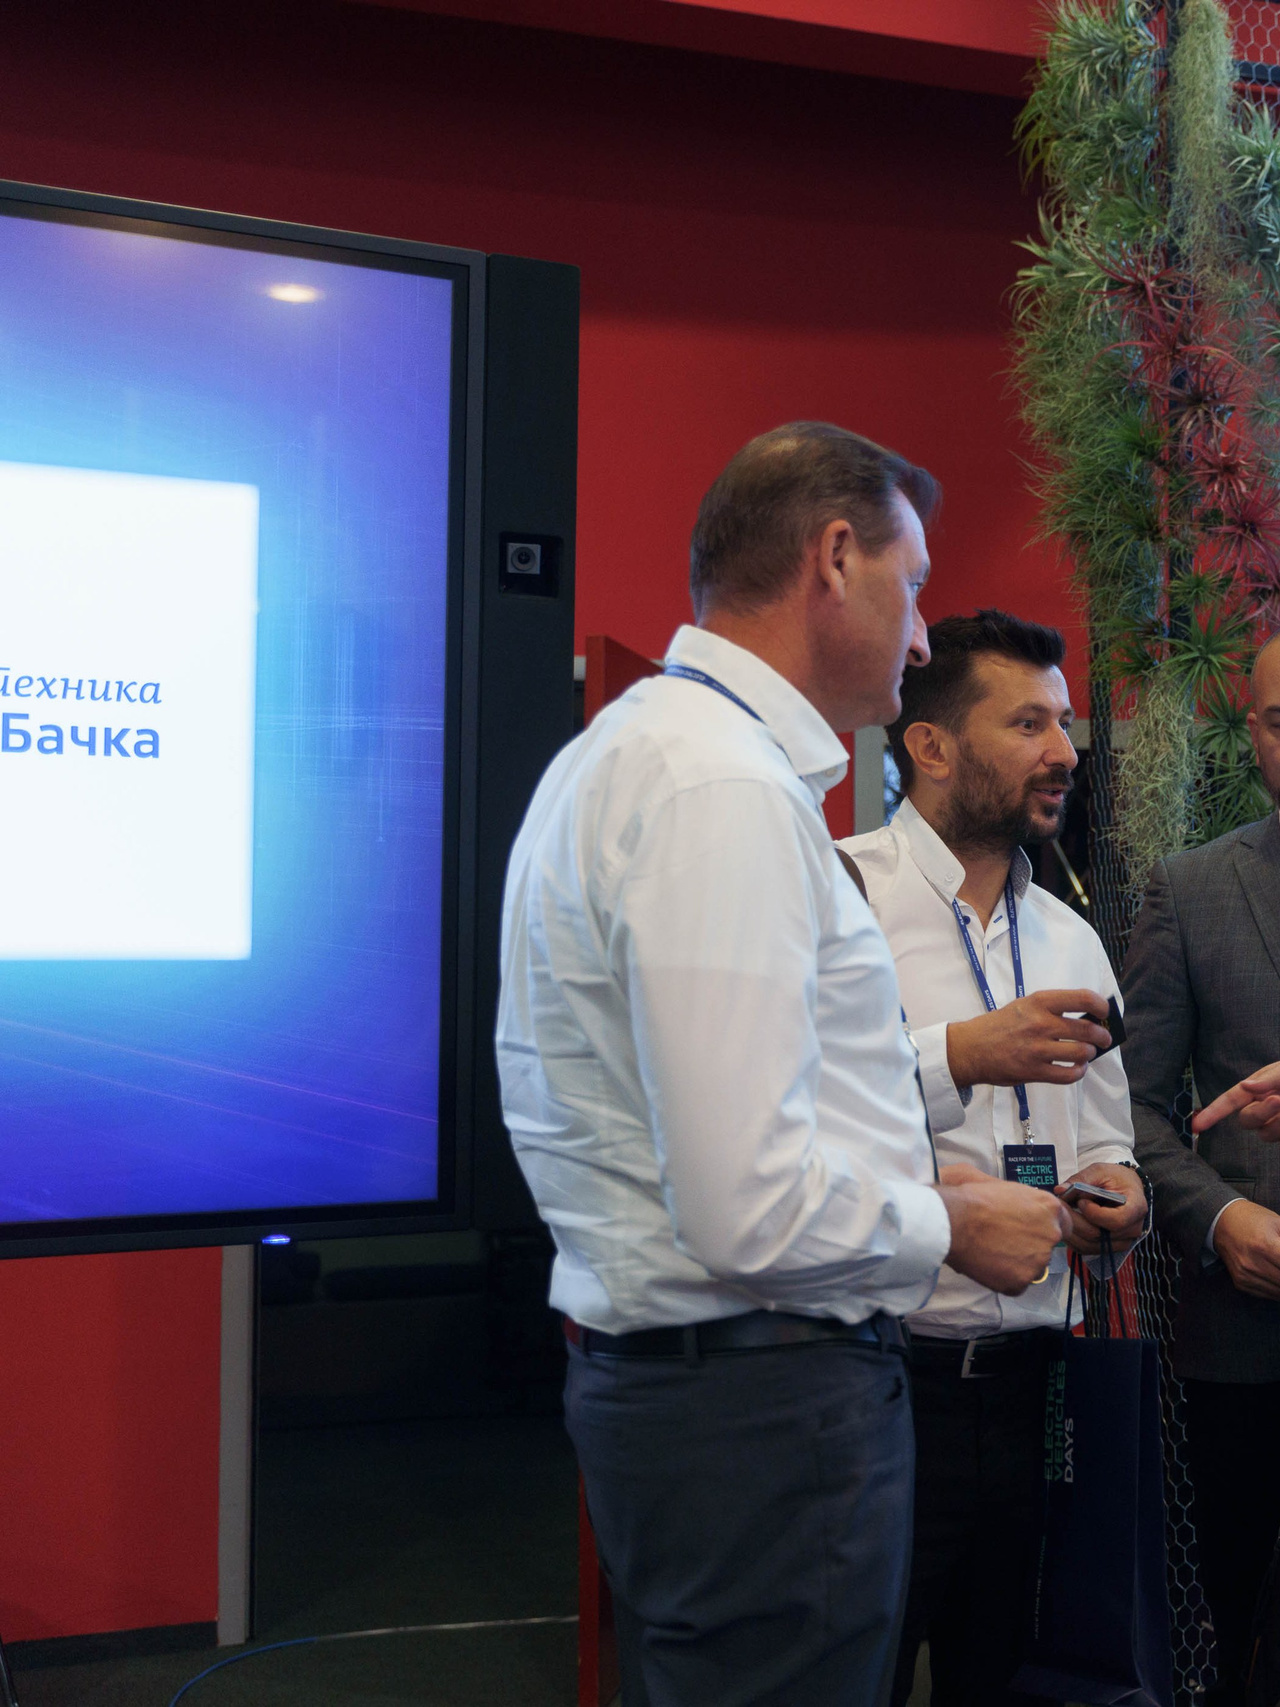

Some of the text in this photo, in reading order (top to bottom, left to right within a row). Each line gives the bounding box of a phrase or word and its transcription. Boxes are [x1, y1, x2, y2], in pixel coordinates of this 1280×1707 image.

[1, 712, 160, 759] Бачка
[1017, 1165, 1053, 1175] ELECTRIC
[1018, 1175, 1055, 1185] VEHICLES
[1044, 1360, 1057, 1481] ELECTRIC
[1054, 1360, 1066, 1481] VEHICLES
[1064, 1417, 1074, 1483] DAYS
